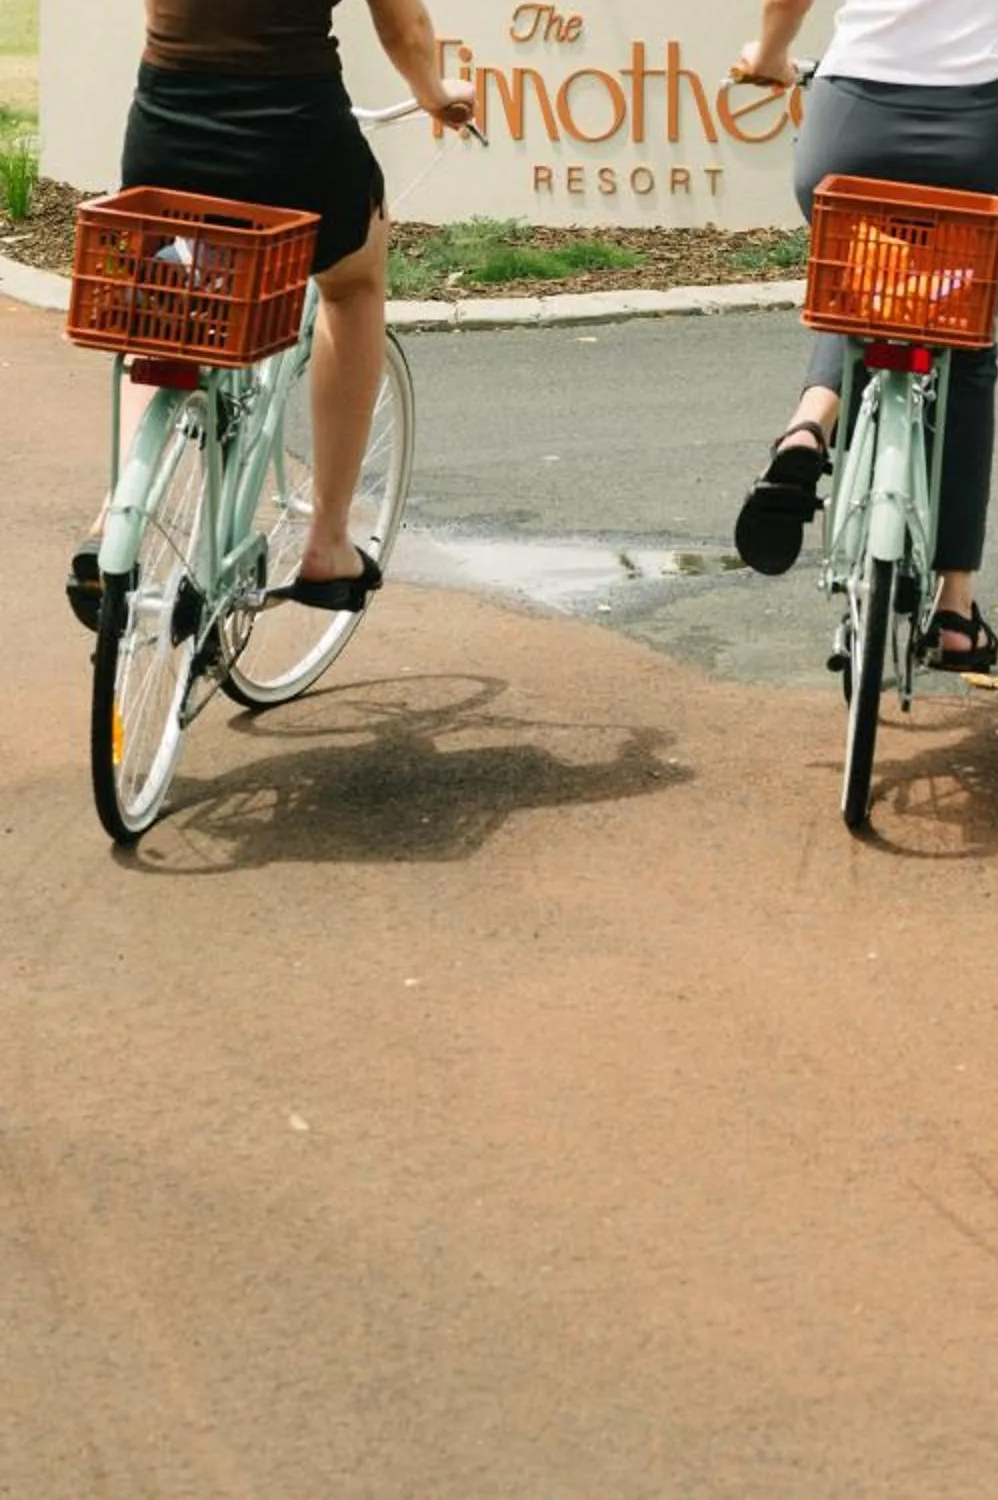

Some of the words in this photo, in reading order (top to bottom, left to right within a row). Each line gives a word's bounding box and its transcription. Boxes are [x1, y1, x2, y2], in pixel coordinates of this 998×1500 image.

[510, 3, 583, 42] The
[431, 39, 804, 144] Timothe
[533, 165, 723, 196] RESORT
